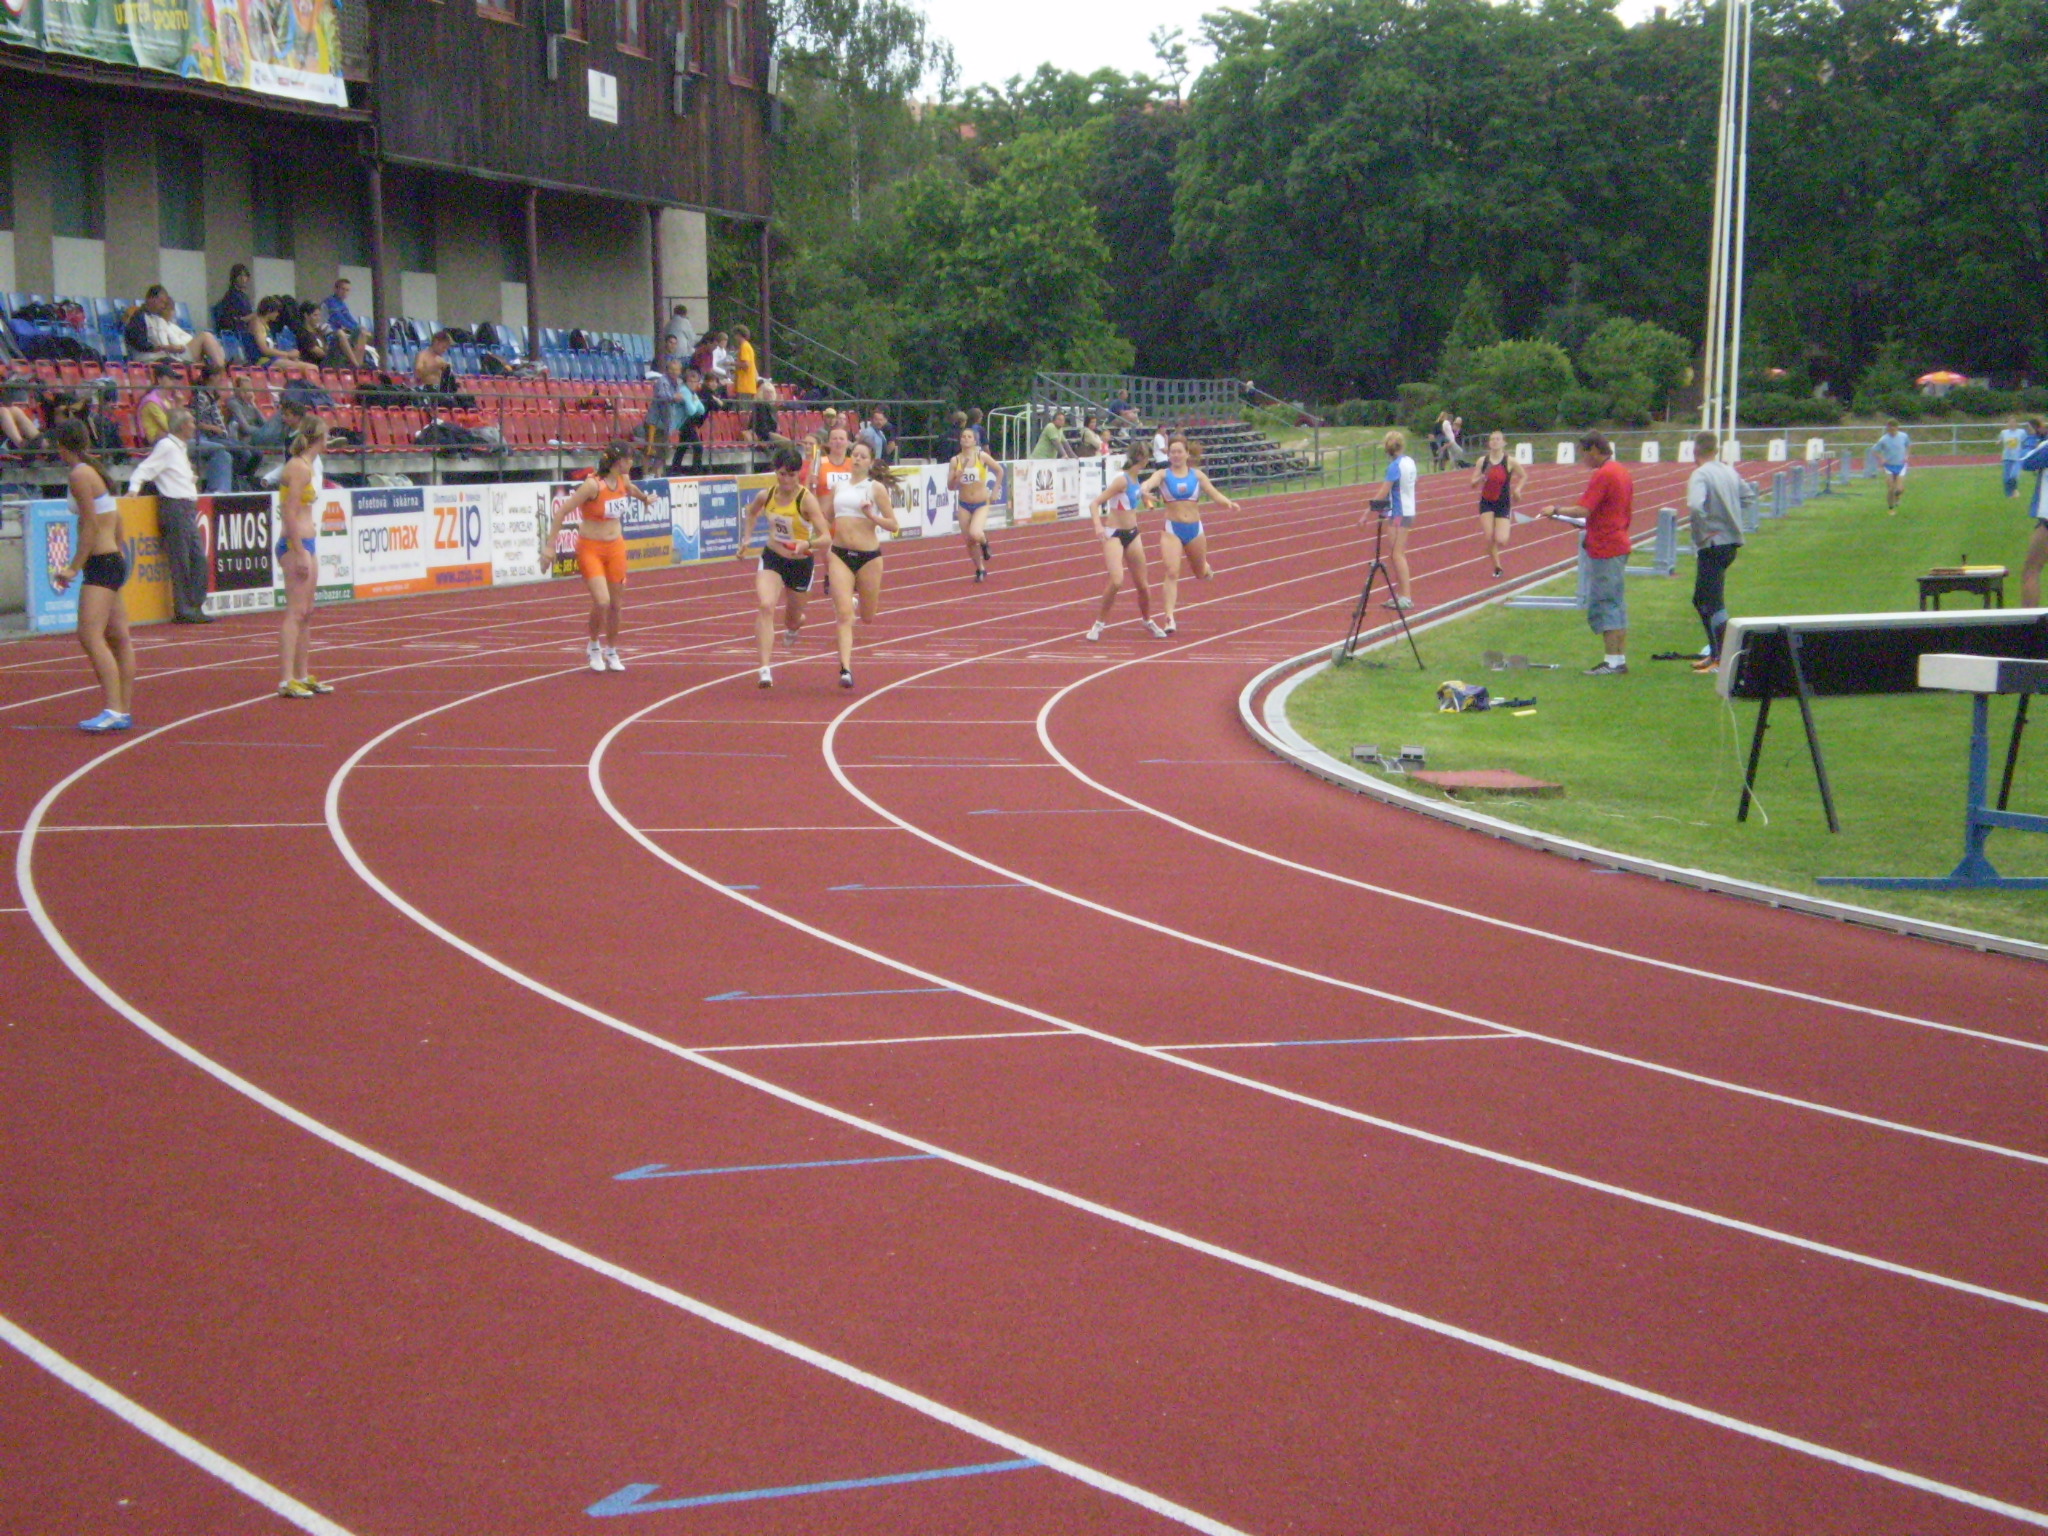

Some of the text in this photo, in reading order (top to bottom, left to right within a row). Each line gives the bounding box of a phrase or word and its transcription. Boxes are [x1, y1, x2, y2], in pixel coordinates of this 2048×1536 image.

[963, 473, 976, 483] 30
[217, 512, 269, 551] AMOS
[358, 525, 420, 562] repromax
[433, 491, 482, 561] zzip
[217, 555, 269, 573] STUDIO
